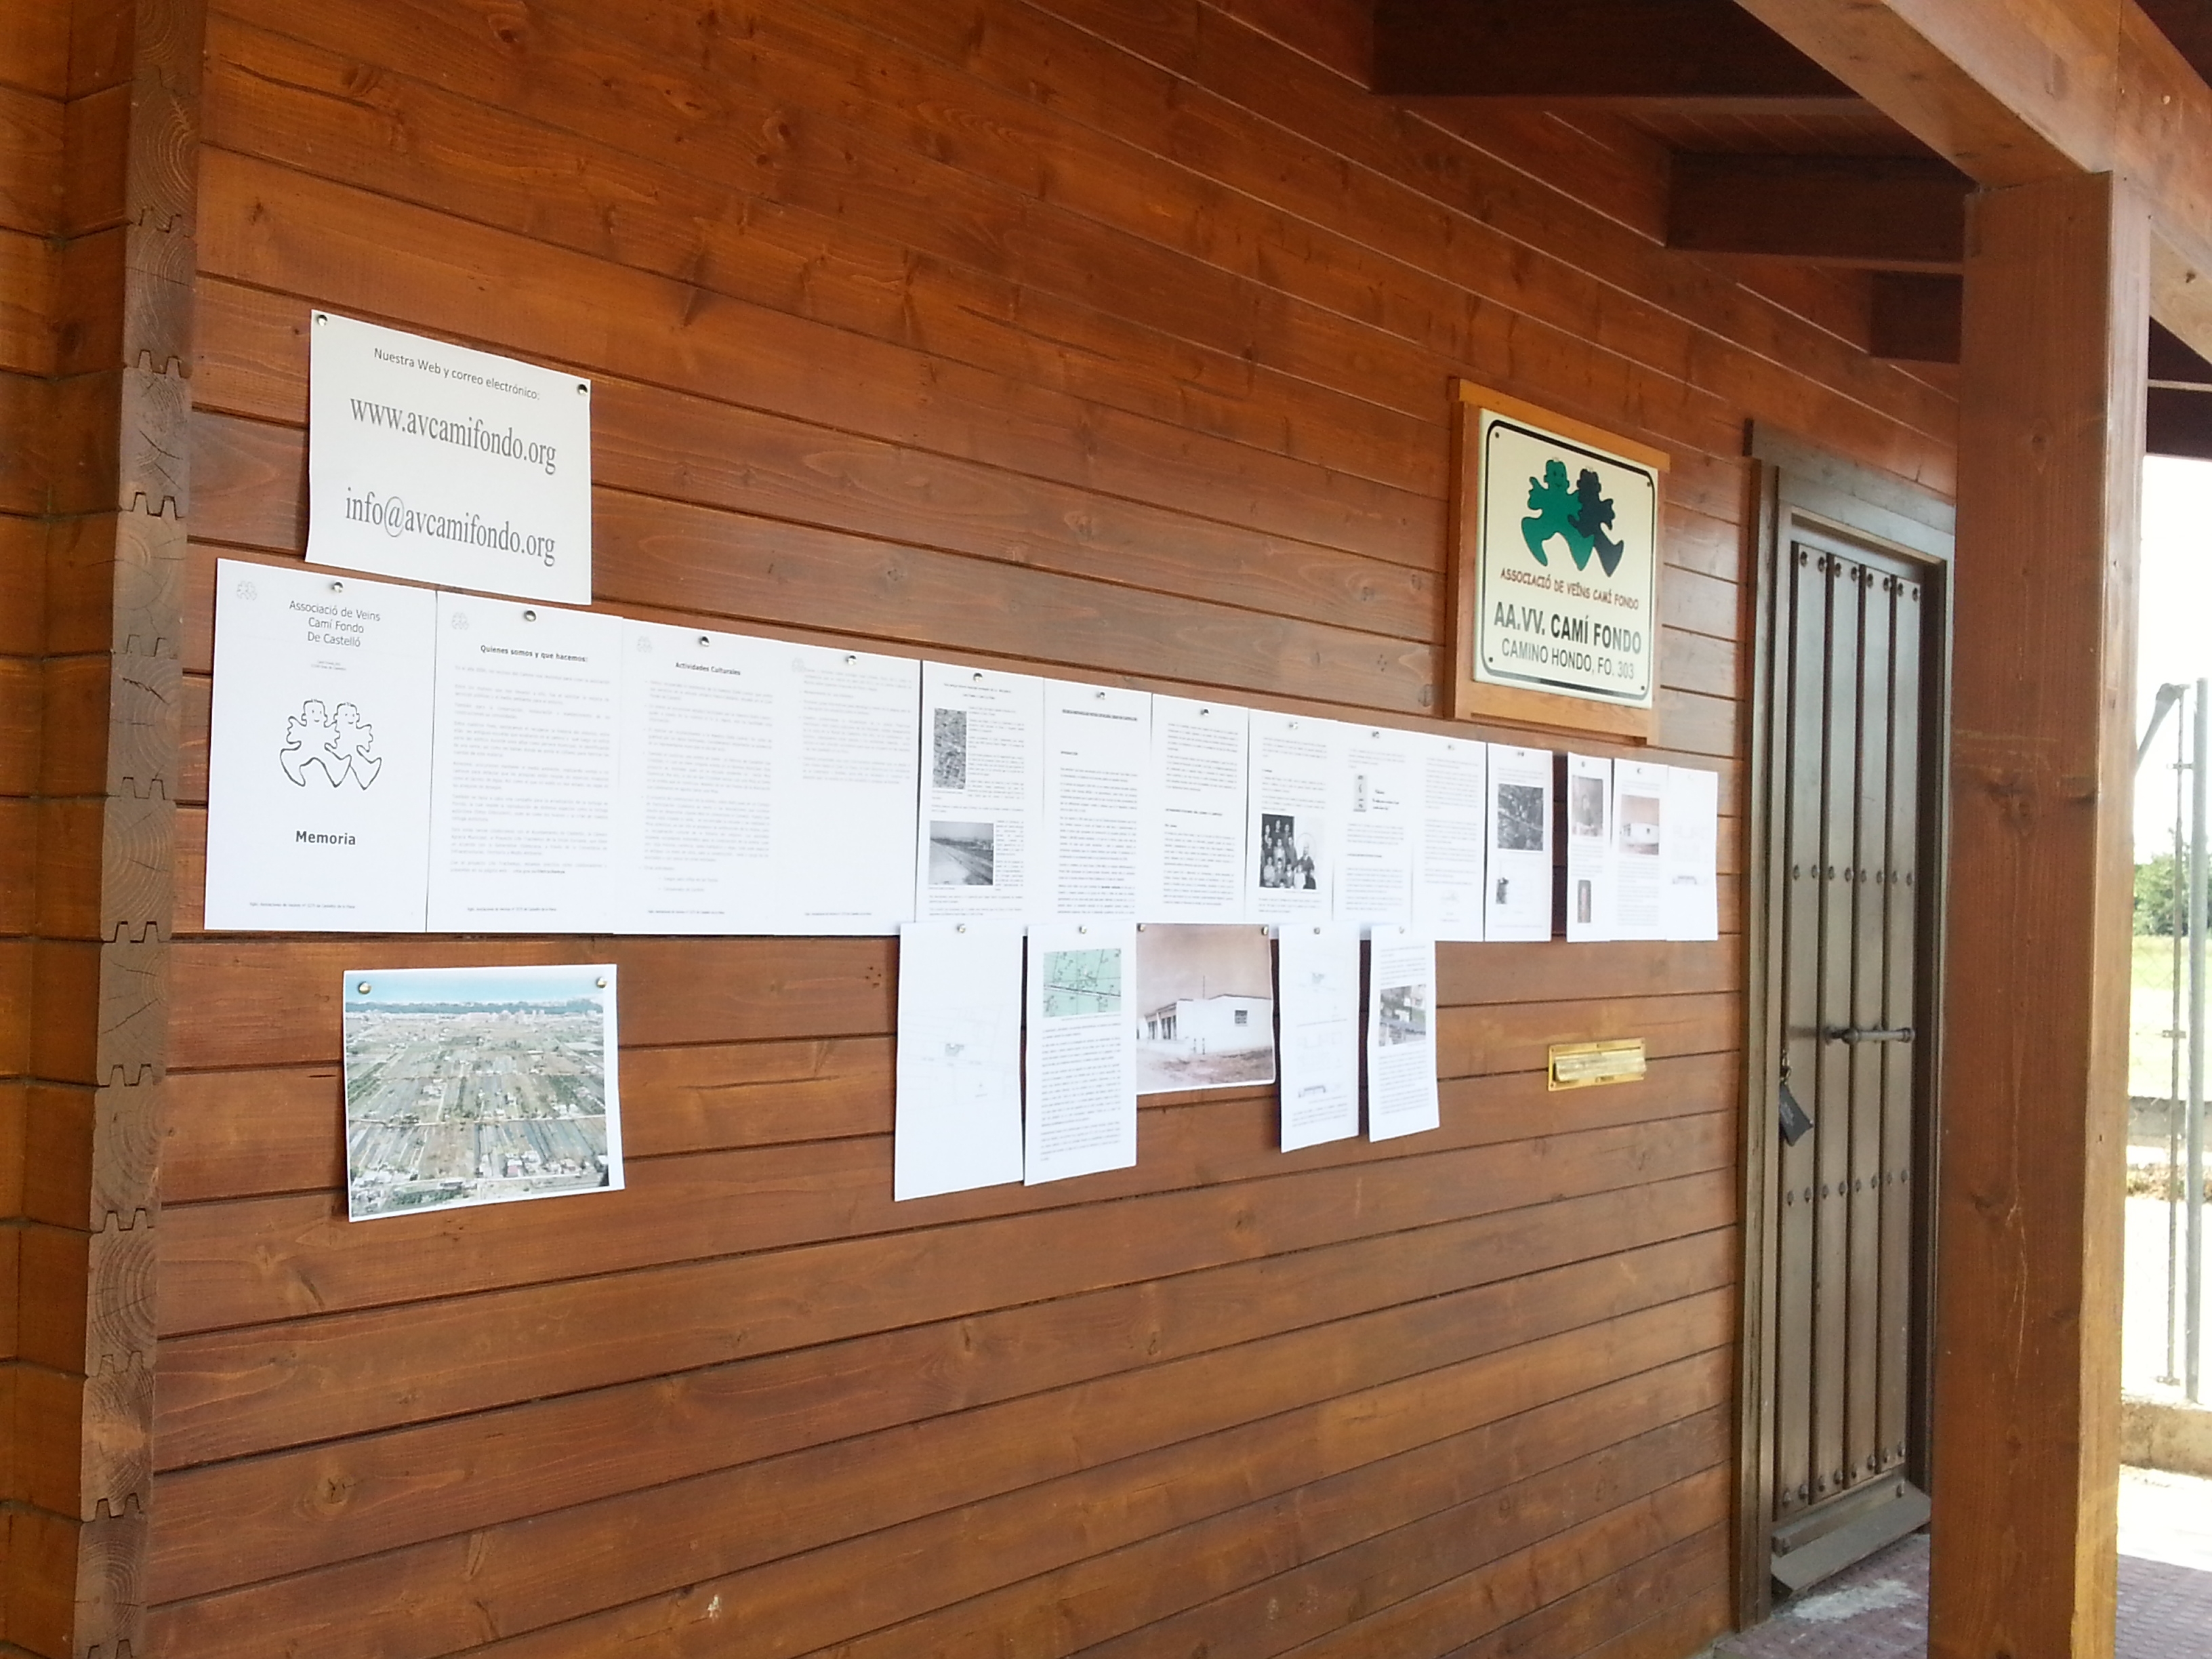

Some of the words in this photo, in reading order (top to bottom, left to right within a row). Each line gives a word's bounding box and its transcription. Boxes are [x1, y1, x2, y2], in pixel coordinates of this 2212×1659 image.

[374, 348, 415, 367] Nuestra
[417, 359, 441, 374] Web
[444, 368, 450, 378] y
[451, 369, 483, 385] correo
[486, 377, 540, 400] electrónico:
[350, 398, 556, 475] www.avcamifondo.org
[346, 487, 556, 567] info@avcamifondo.org
[289, 600, 338, 615] Associació
[341, 607, 352, 618] de
[1500, 567, 1551, 590] ASSOCIACIÓ
[1554, 579, 1564, 593] DE
[1593, 588, 1612, 605] CAMÍ
[1614, 595, 1639, 610] FONDO
[308, 617, 333, 629] Camí
[335, 620, 364, 633] Fondo
[308, 631, 321, 642] De
[323, 634, 361, 647] Castelló
[1494, 601, 1545, 636] AA.VV.
[1551, 613, 1589, 644] CAMÍ
[1594, 623, 1641, 655] FONDO
[480, 644, 508, 655] Quienes
[510, 649, 533, 657] somos
[1502, 638, 1549, 663] CAMINO
[1552, 647, 1595, 674] HONDO,
[1598, 657, 1614, 676] FO.
[1618, 661, 1634, 679] 303
[295, 830, 356, 845] Memoria
